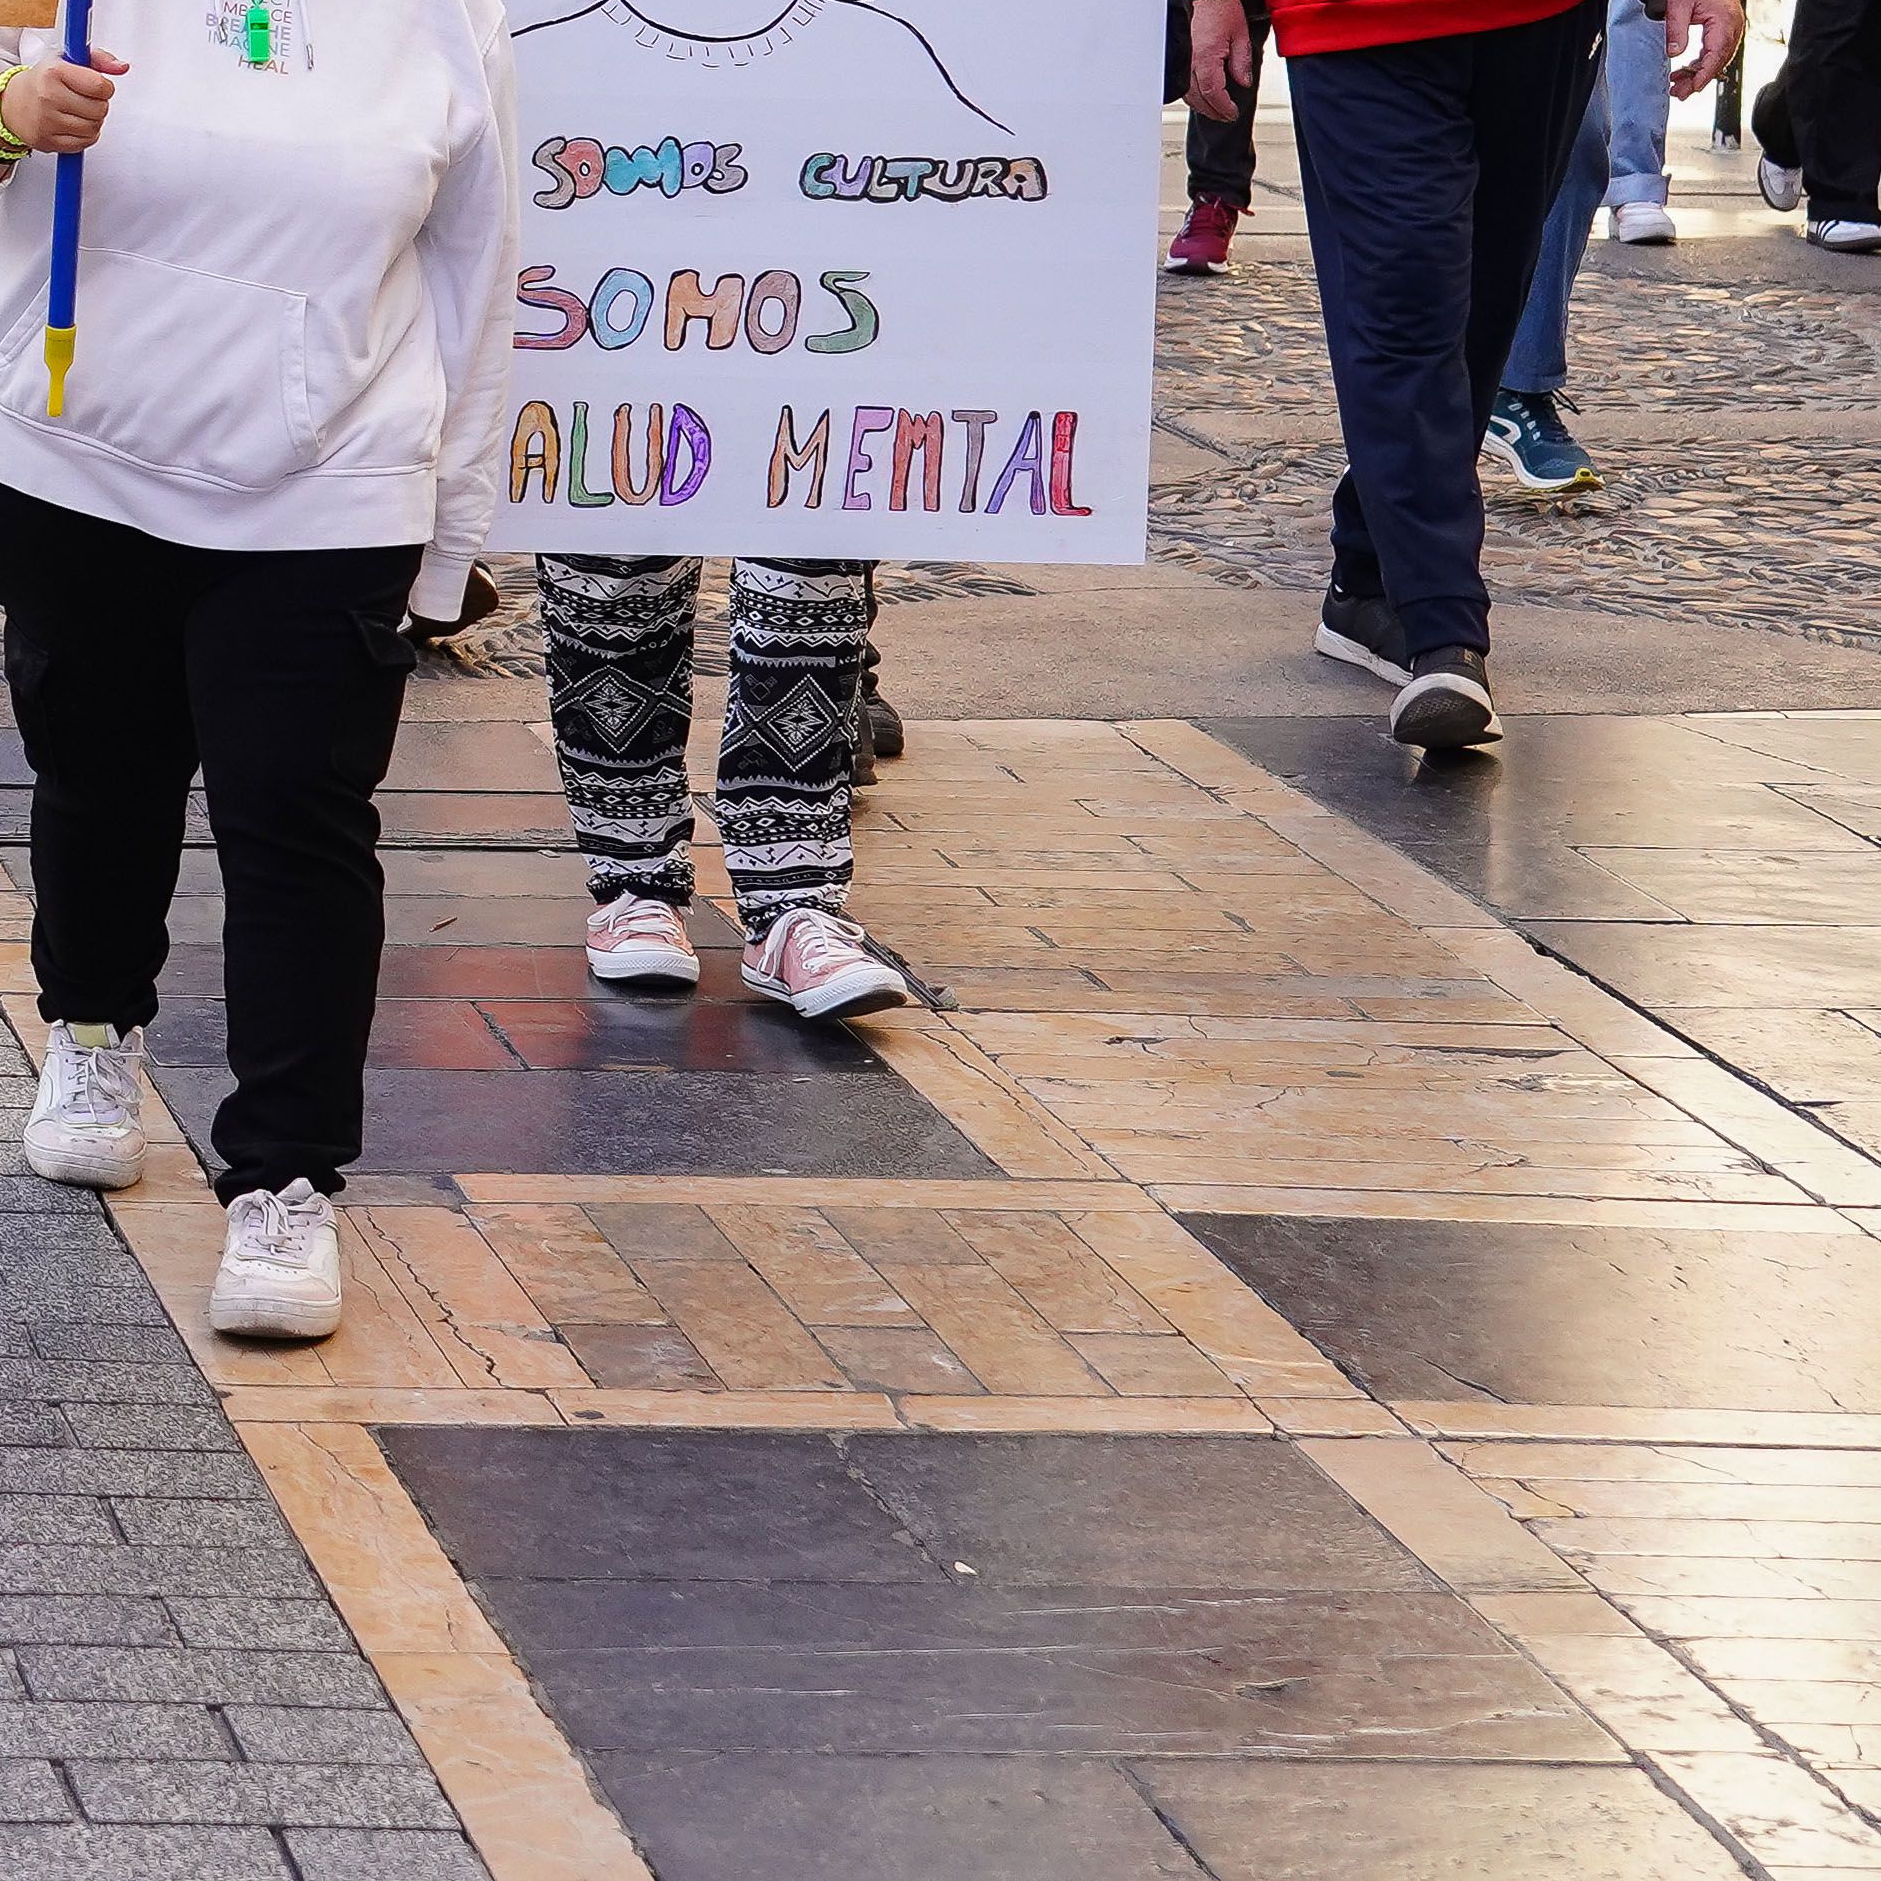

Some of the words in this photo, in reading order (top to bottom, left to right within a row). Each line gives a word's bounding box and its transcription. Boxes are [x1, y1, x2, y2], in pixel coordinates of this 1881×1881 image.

[533, 135, 749, 210] SOMOS
[799, 152, 1050, 203] CULTURA
[513, 265, 880, 354] SOMOS
[509, 400, 712, 507] ALUD
